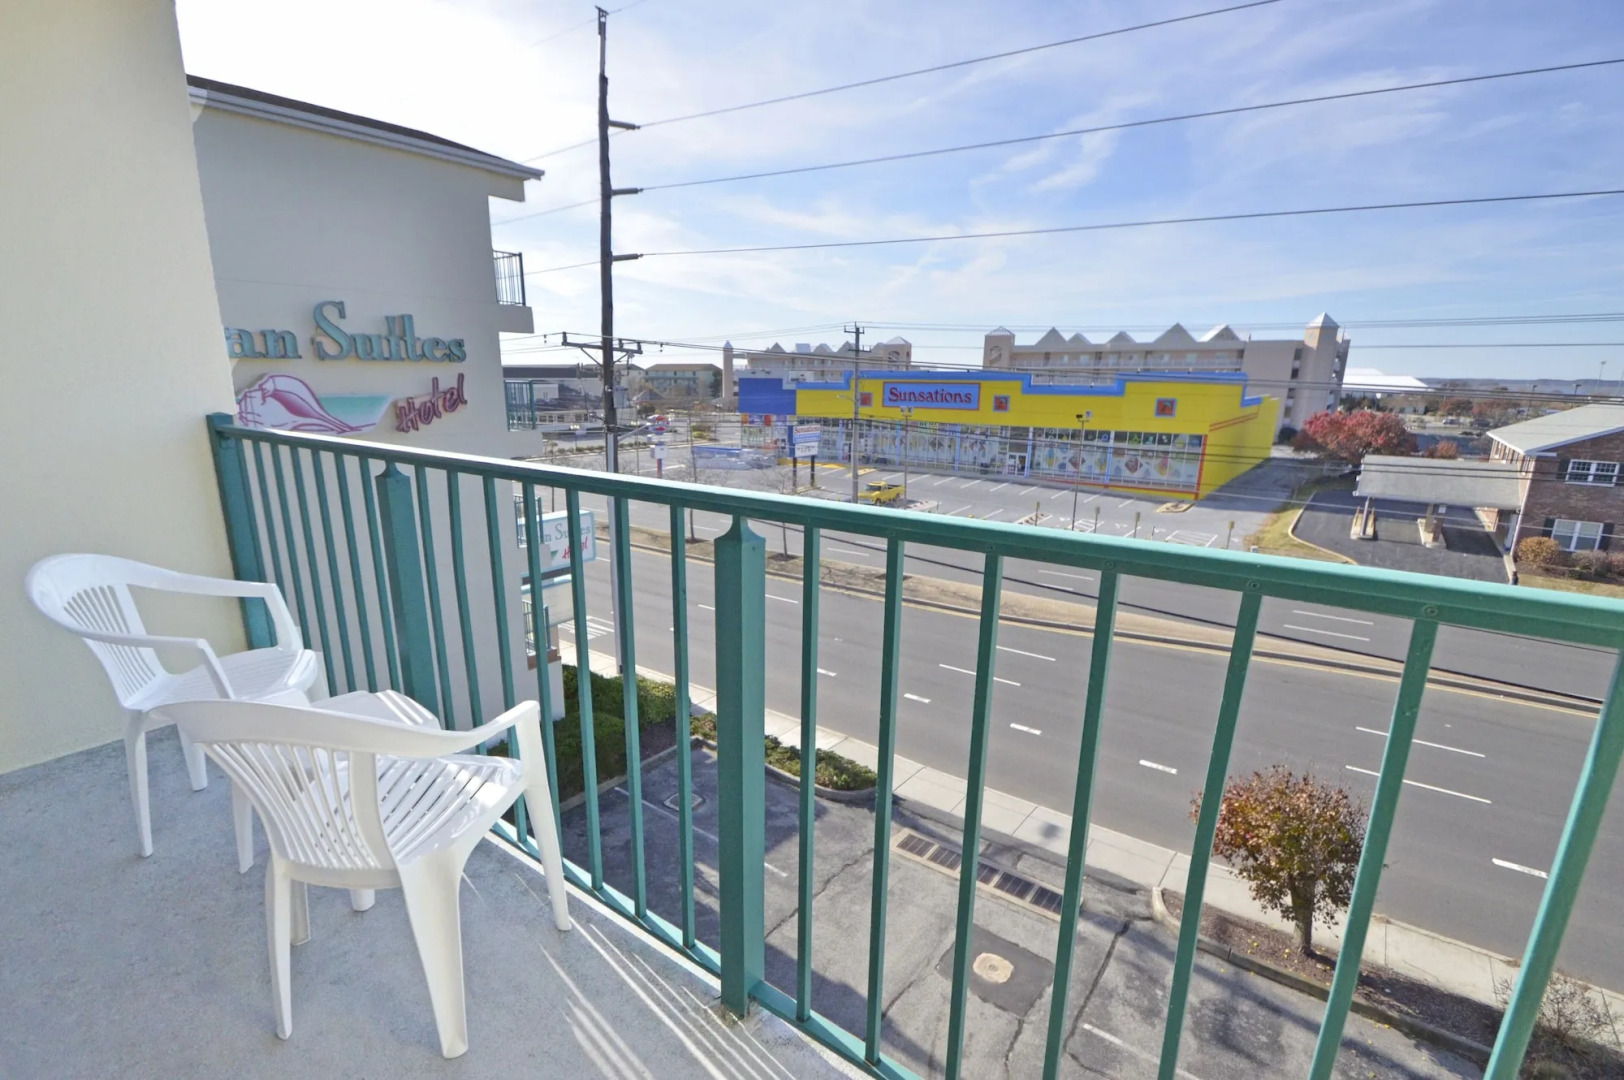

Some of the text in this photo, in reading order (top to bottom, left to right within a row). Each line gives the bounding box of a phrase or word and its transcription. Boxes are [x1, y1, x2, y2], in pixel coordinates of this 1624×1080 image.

[312, 300, 467, 362] Suites
[396, 373, 467, 433] Hotel
[888, 387, 972, 404] Sunsations
[555, 523, 590, 540] Sues
[562, 536, 588, 560] Hel
